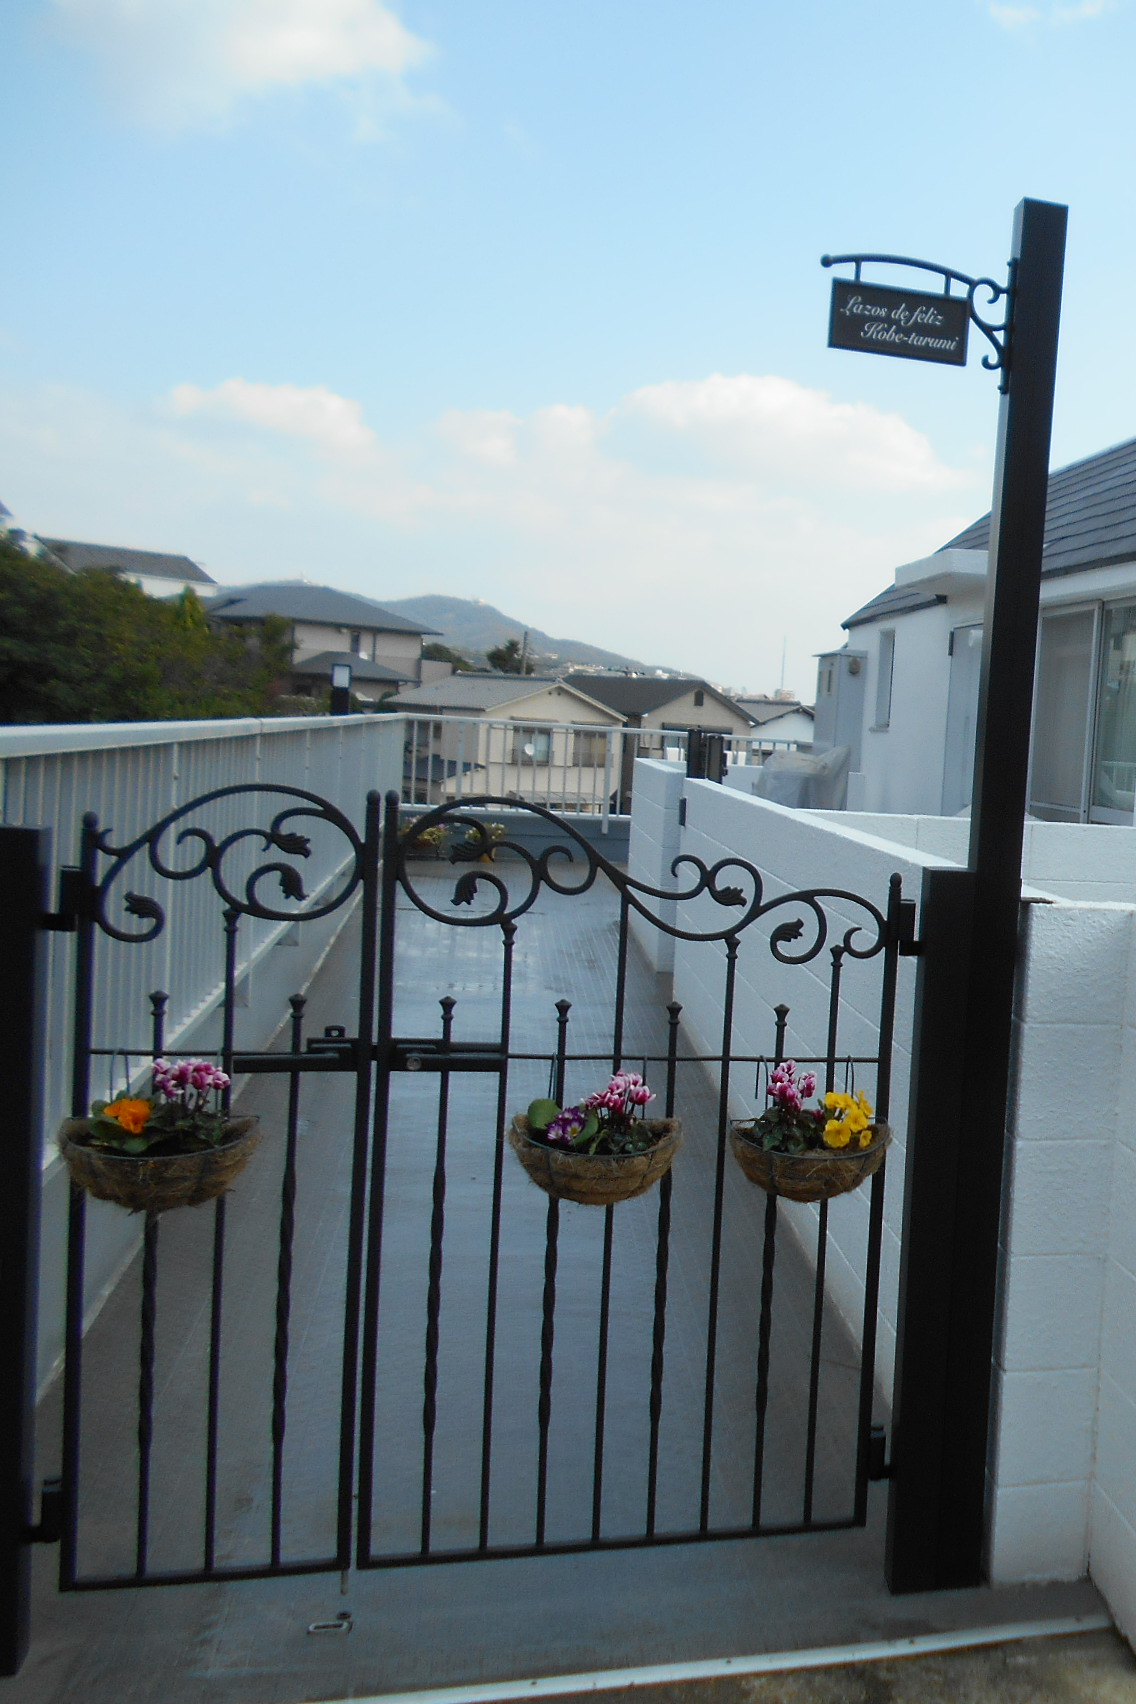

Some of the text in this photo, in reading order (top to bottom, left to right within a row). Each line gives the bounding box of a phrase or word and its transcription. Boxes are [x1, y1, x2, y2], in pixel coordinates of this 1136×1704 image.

[840, 295, 944, 326] Lazos de feliz
[860, 321, 959, 351] Kobe-tarumi
